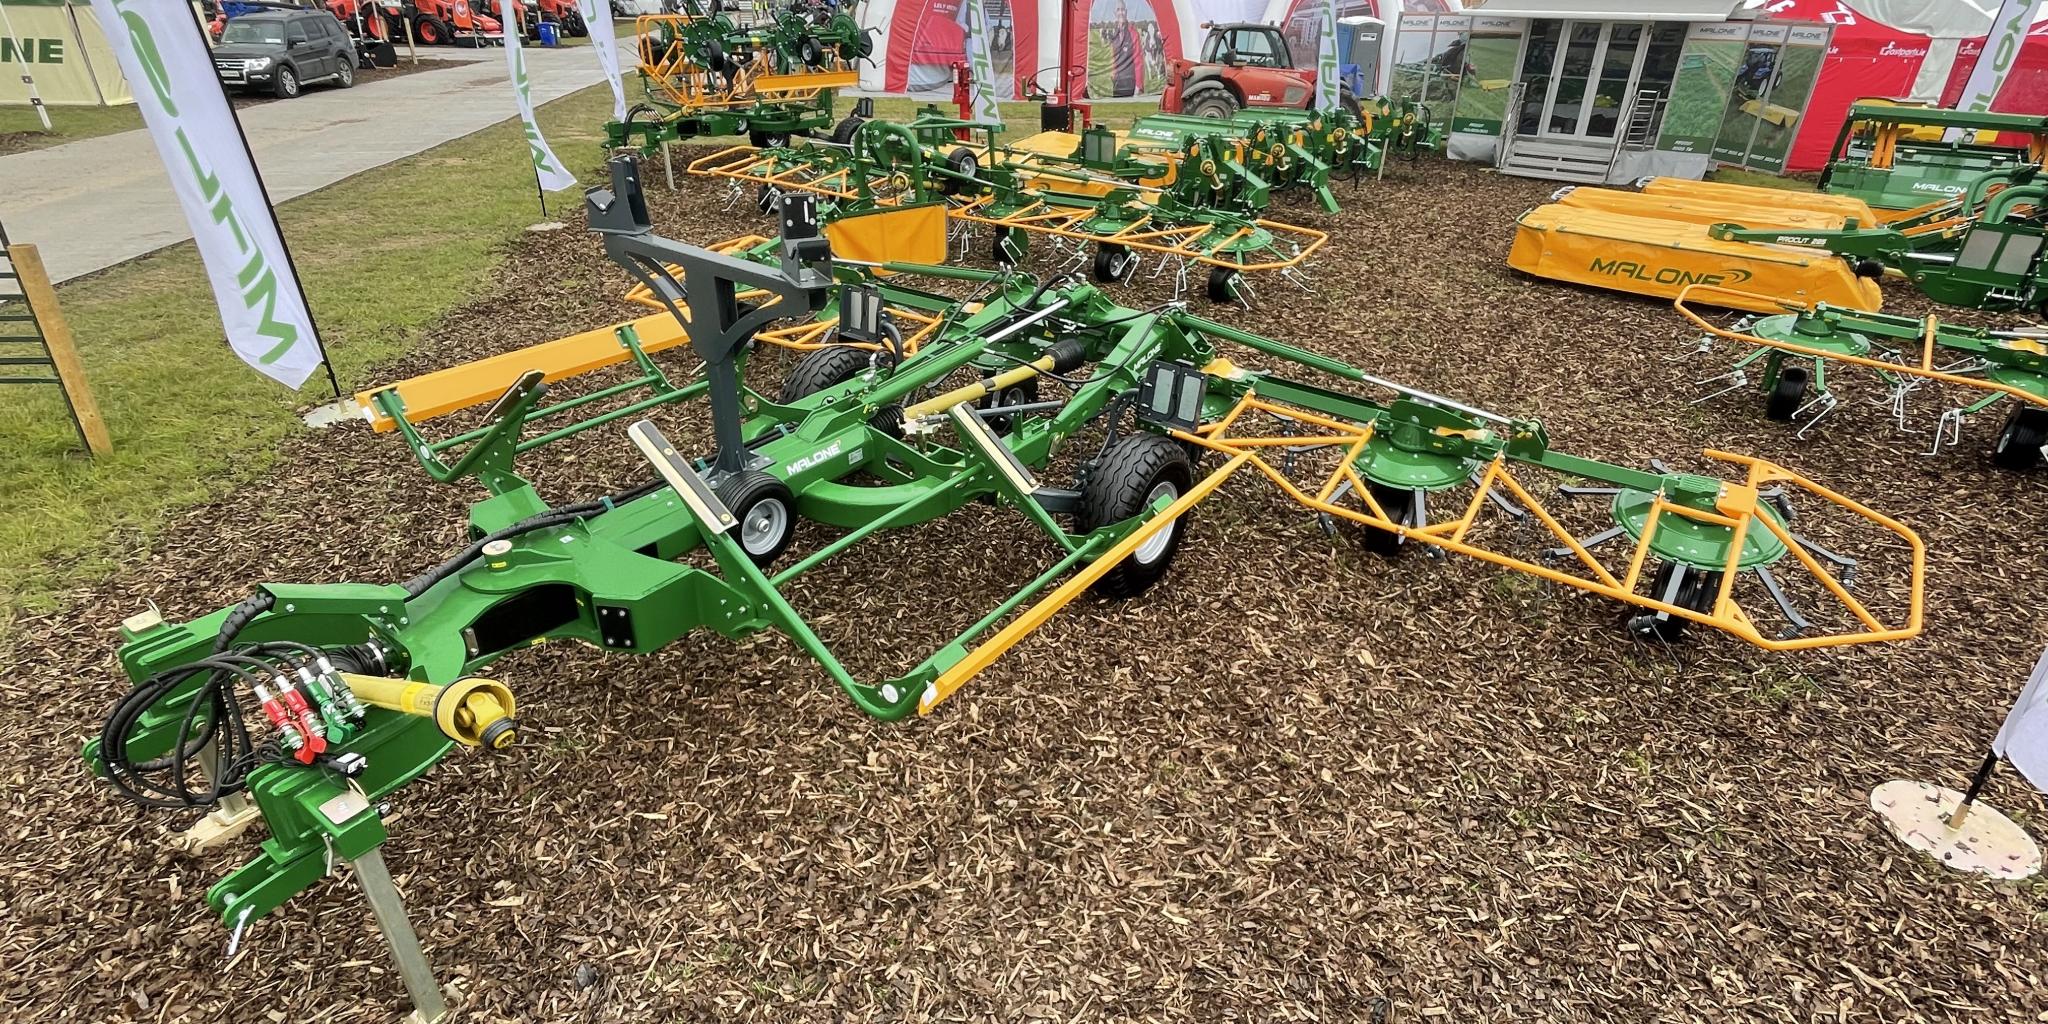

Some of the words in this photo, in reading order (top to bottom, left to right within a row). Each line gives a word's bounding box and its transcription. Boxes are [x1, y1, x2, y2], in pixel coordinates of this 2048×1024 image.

[1700, 27, 1736, 35] MALONE
[1791, 31, 1821, 40] MALONE
[1136, 128, 1173, 138] MALONE
[1912, 182, 1967, 192] MALON
[1776, 235, 1810, 244] PROCUT
[1589, 257, 1726, 286] MALONE
[1133, 342, 1162, 371] MALONE
[786, 443, 841, 476] MALONE
